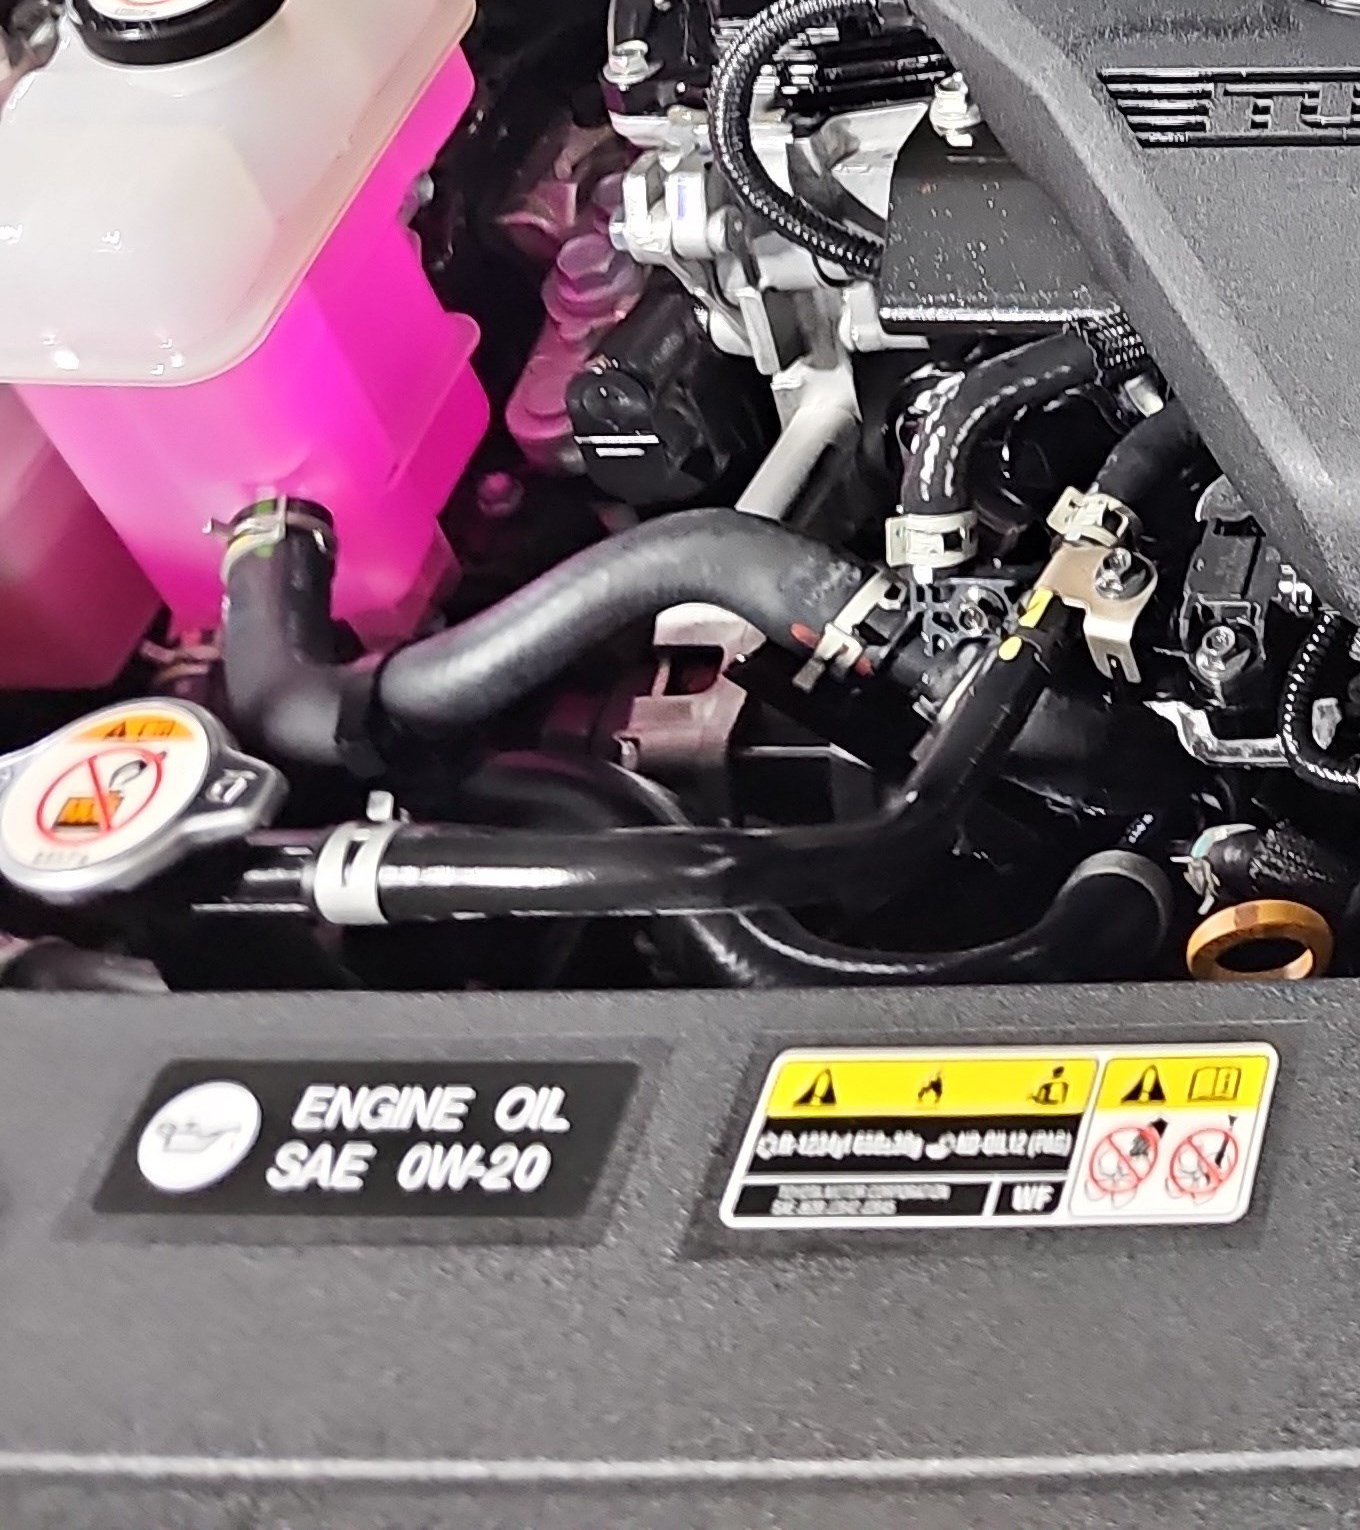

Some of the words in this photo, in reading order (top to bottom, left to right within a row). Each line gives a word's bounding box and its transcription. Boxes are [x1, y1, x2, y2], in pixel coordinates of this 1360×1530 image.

[291, 1085, 474, 1133] ENGINE
[494, 1086, 571, 1134] OIL
[266, 1142, 374, 1192] SAE
[396, 1143, 552, 1192] 0W-20
